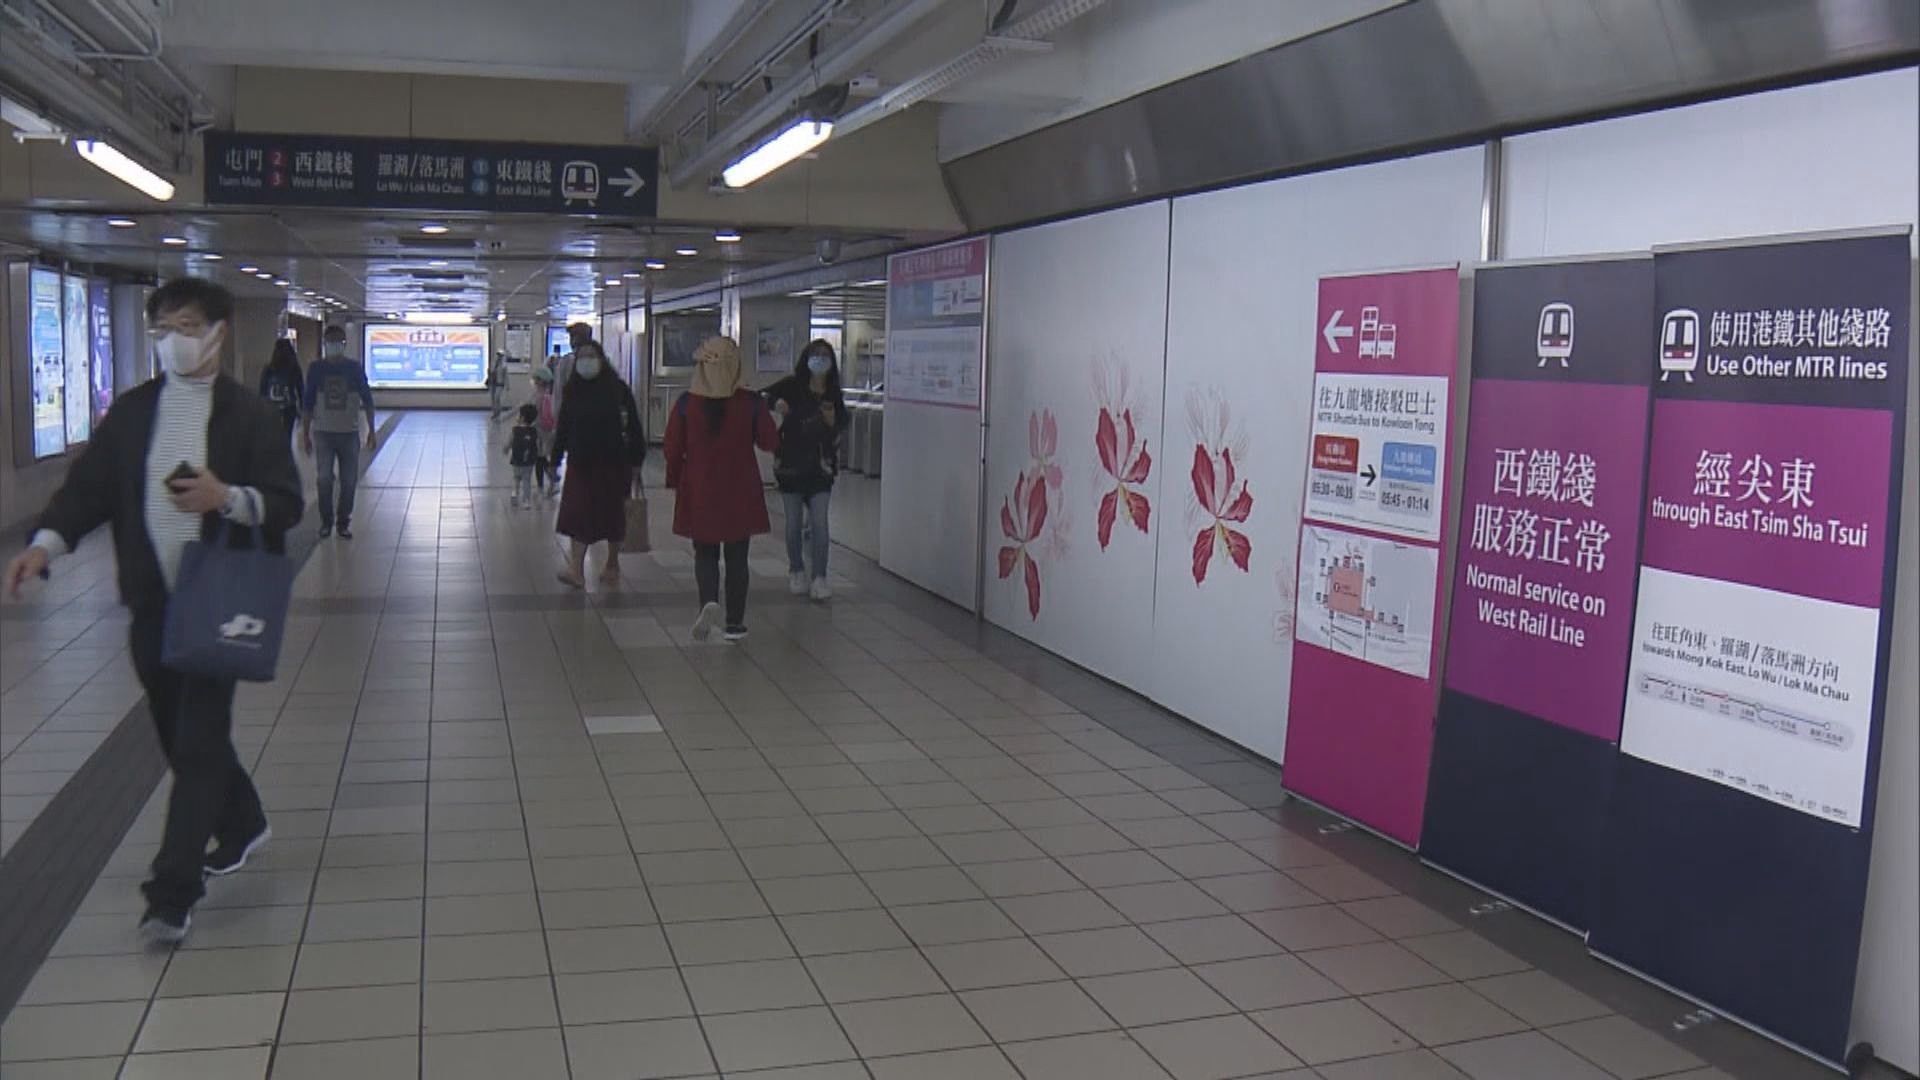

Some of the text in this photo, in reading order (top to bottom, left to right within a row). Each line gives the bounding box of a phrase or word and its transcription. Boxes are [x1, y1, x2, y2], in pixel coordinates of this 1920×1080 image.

[225, 147, 263, 172] 屯門
[271, 152, 282, 165] 2
[271, 172, 281, 185] 3
[291, 176, 354, 189] West Rail Line
[376, 181, 386, 192] Lo
[388, 182, 403, 192] Wu
[410, 182, 425, 193] Lok
[428, 183, 441, 193] Ma
[442, 184, 464, 194] Chau
[496, 185, 551, 197] East Rail Line
[1710, 307, 1891, 348] 使用港鐵其他綫路
[1706, 354, 1887, 379] Use Other MTR lines
[1317, 412, 1332, 422] MTR
[1333, 412, 1357, 425] Shuttle
[1372, 416, 1380, 427] to
[1382, 416, 1413, 429] Kowloon
[1414, 418, 1435, 434] Tong
[1494, 448, 1596, 507] 西鐵綫
[1693, 449, 1816, 509] 經尖東
[1381, 491, 1400, 508] 05:45
[1406, 495, 1429, 511] 01:14
[1652, 496, 1868, 548] through East Tsim Sha Tsui
[1471, 503, 1611, 573] 服務正常
[1466, 563, 1606, 617] Normal service on
[1478, 598, 1585, 647] West Rail Line
[1642, 642, 1675, 660] towards
[1676, 649, 1704, 668] Mong
[1706, 654, 1724, 670] Kok
[1748, 665, 1760, 679] Lo
[1761, 669, 1777, 683] Wu
[1784, 673, 1801, 689] Lok
[1803, 681, 1819, 695] Ma
[1821, 684, 1849, 701] Chau
